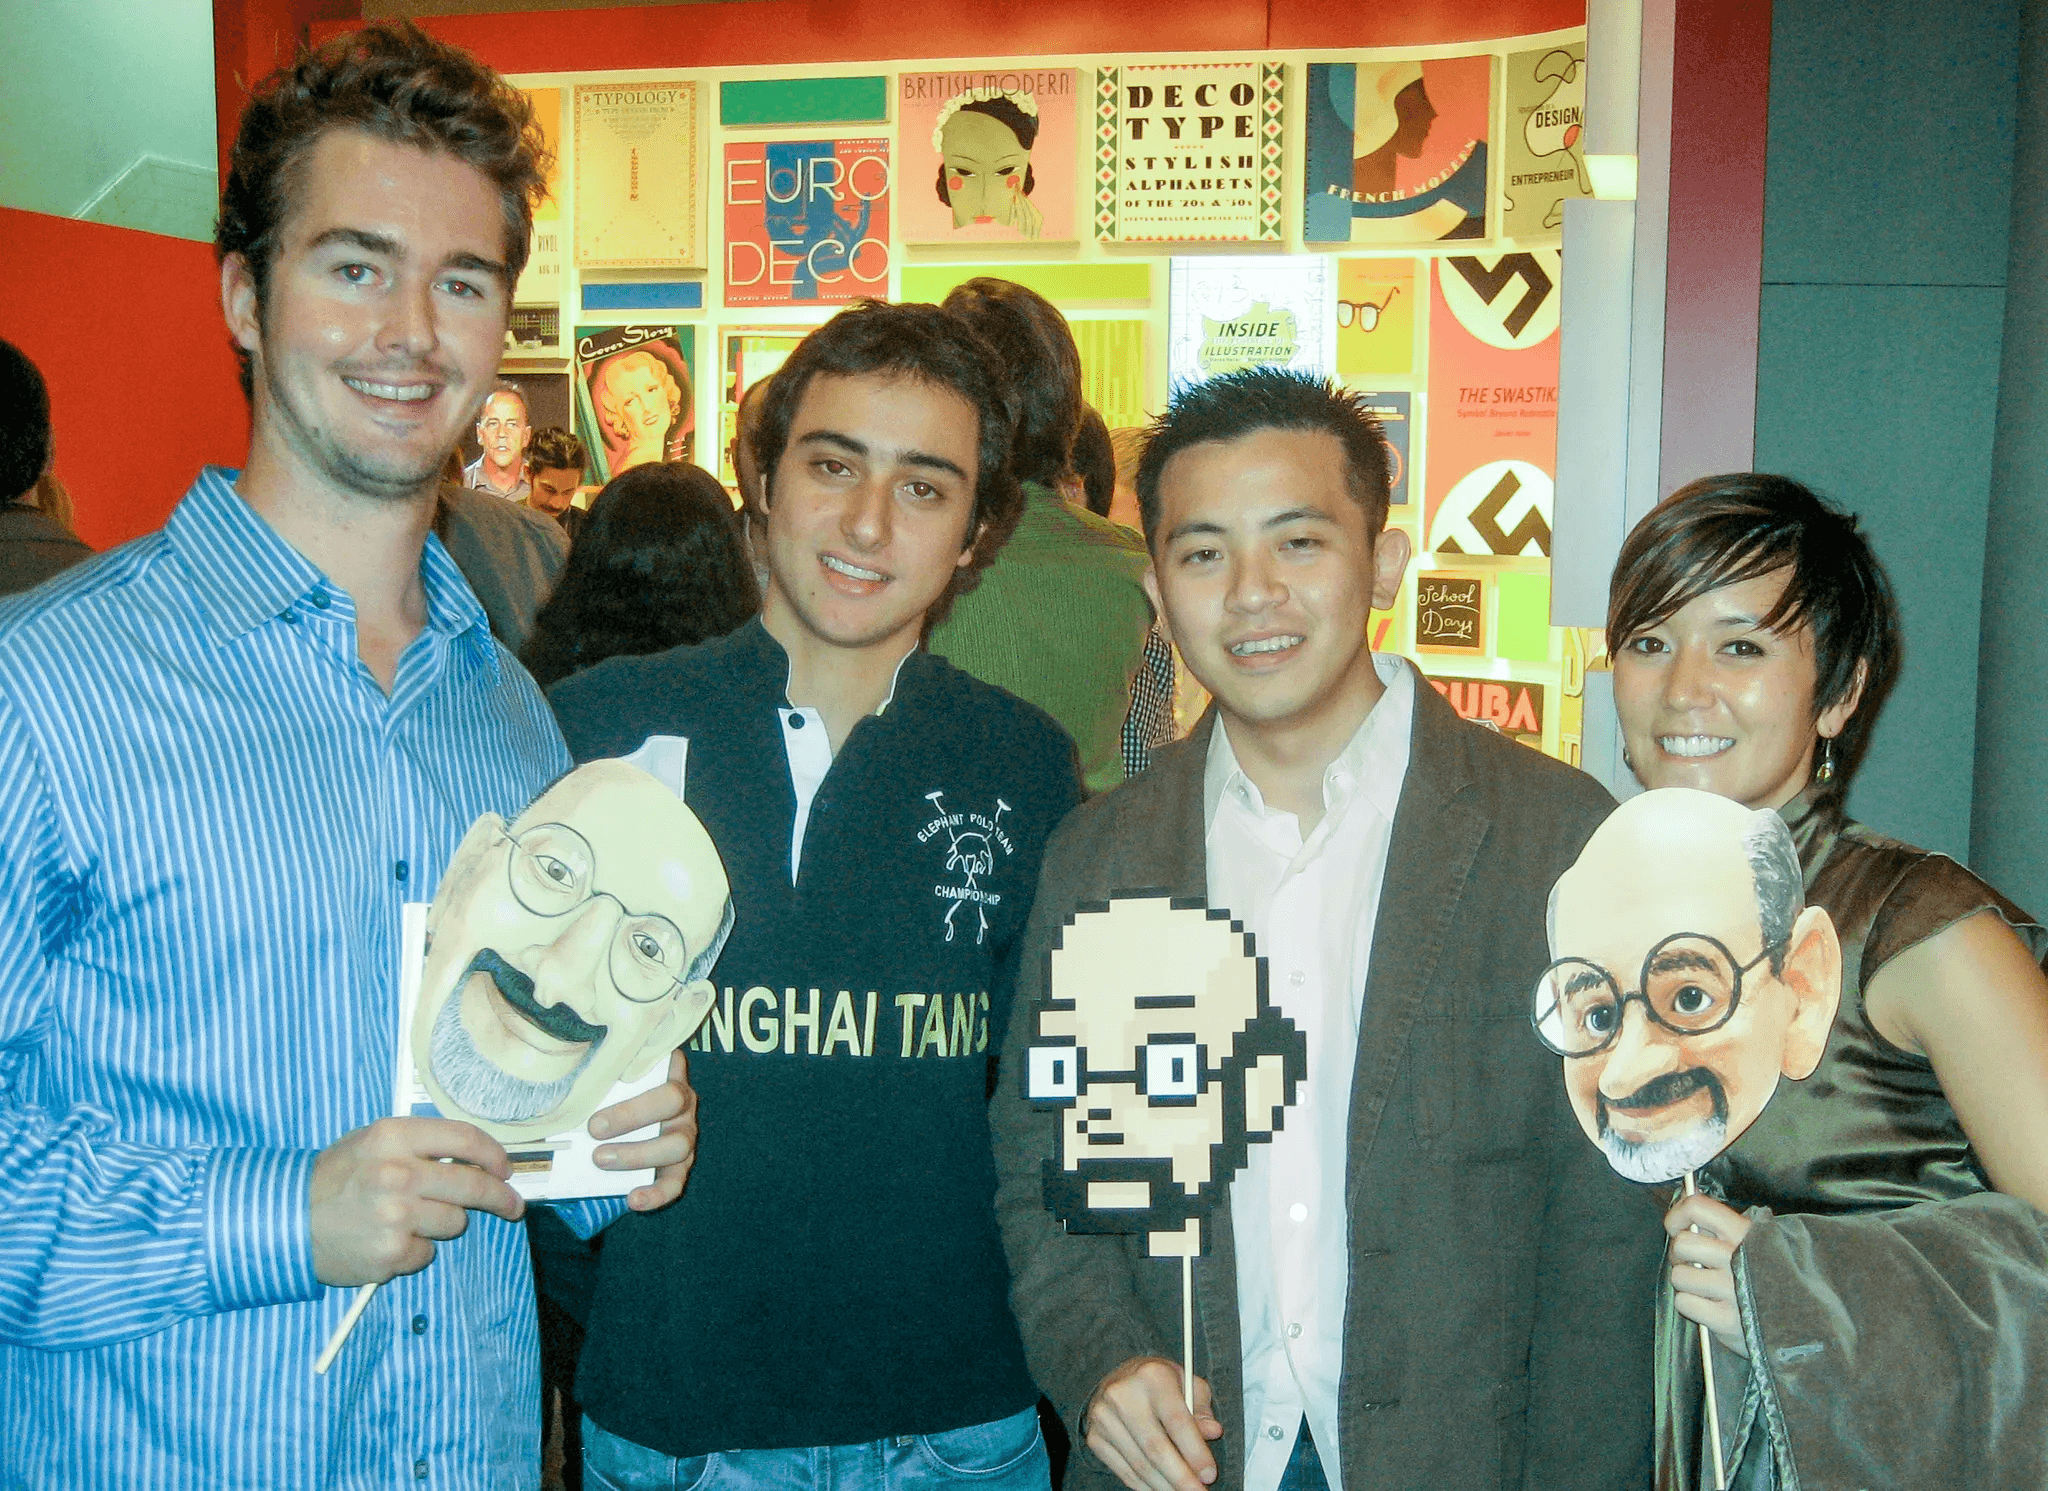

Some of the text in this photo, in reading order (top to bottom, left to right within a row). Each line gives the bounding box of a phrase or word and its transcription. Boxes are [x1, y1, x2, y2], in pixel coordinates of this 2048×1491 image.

[904, 72, 1070, 99] BRITISH MODERN
[1126, 83, 1255, 108] DECO
[594, 90, 678, 105] TYPOLOGY
[1126, 115, 1254, 140] TYPE
[1536, 106, 1579, 128] DESIGN
[1125, 155, 1253, 170] STYLISH
[1327, 139, 1477, 203] FRENCH MODERN
[728, 155, 890, 205] EURO
[1126, 178, 1253, 191] ALPHABETS
[1511, 168, 1574, 186] ENTREPRENEUR
[1125, 200, 1141, 208] OF
[1147, 199, 1173, 208] THE
[1211, 199, 1221, 207] &
[728, 238, 890, 286] DECO
[1219, 322, 1280, 337] INSIDE
[579, 325, 673, 359] Cover Story
[1205, 346, 1293, 356] ILLUSTRATION
[1459, 386, 1558, 404] THE SWASTIK
[1418, 584, 1475, 606] School
[1422, 608, 1473, 638] Days
[917, 813, 1014, 856] ELEPHANT POLO TEAM
[690, 986, 877, 1057] NGHAI
